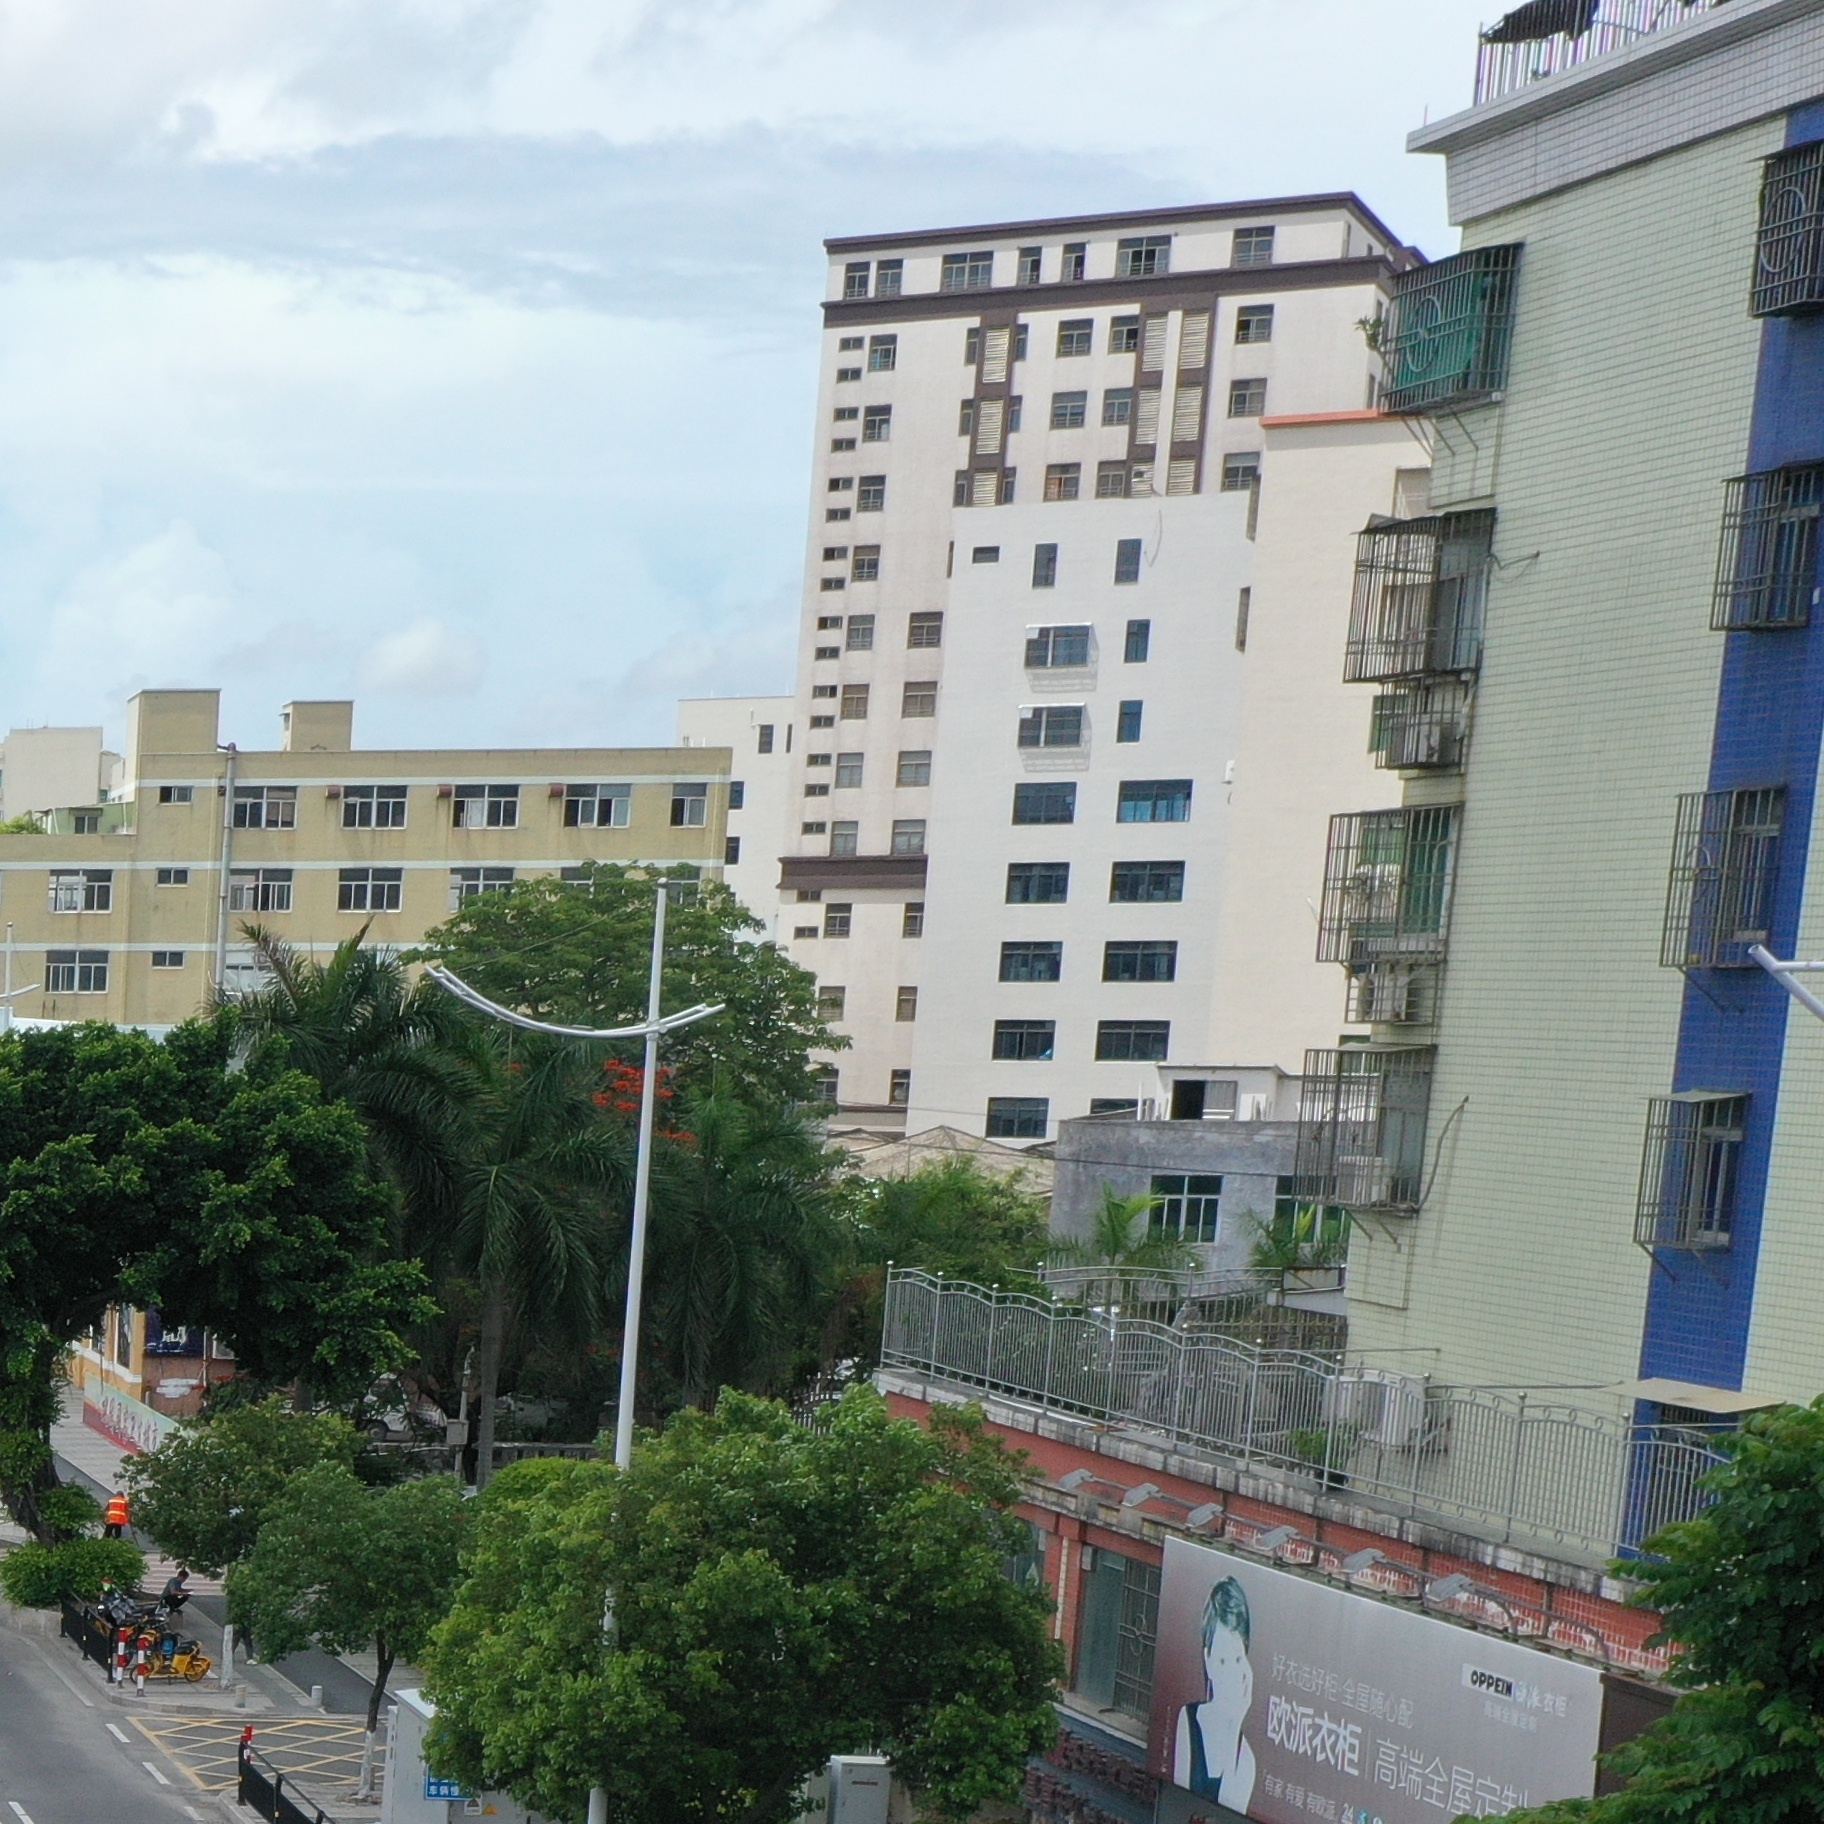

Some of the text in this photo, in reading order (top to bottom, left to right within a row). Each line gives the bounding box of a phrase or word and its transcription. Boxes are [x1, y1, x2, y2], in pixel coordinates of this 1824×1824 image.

[1470, 1669, 1514, 1698] OPPEIN
[1266, 1694, 1363, 1777] 欧派衣柜
[1373, 1737, 1529, 1820] 高端全屋定制
